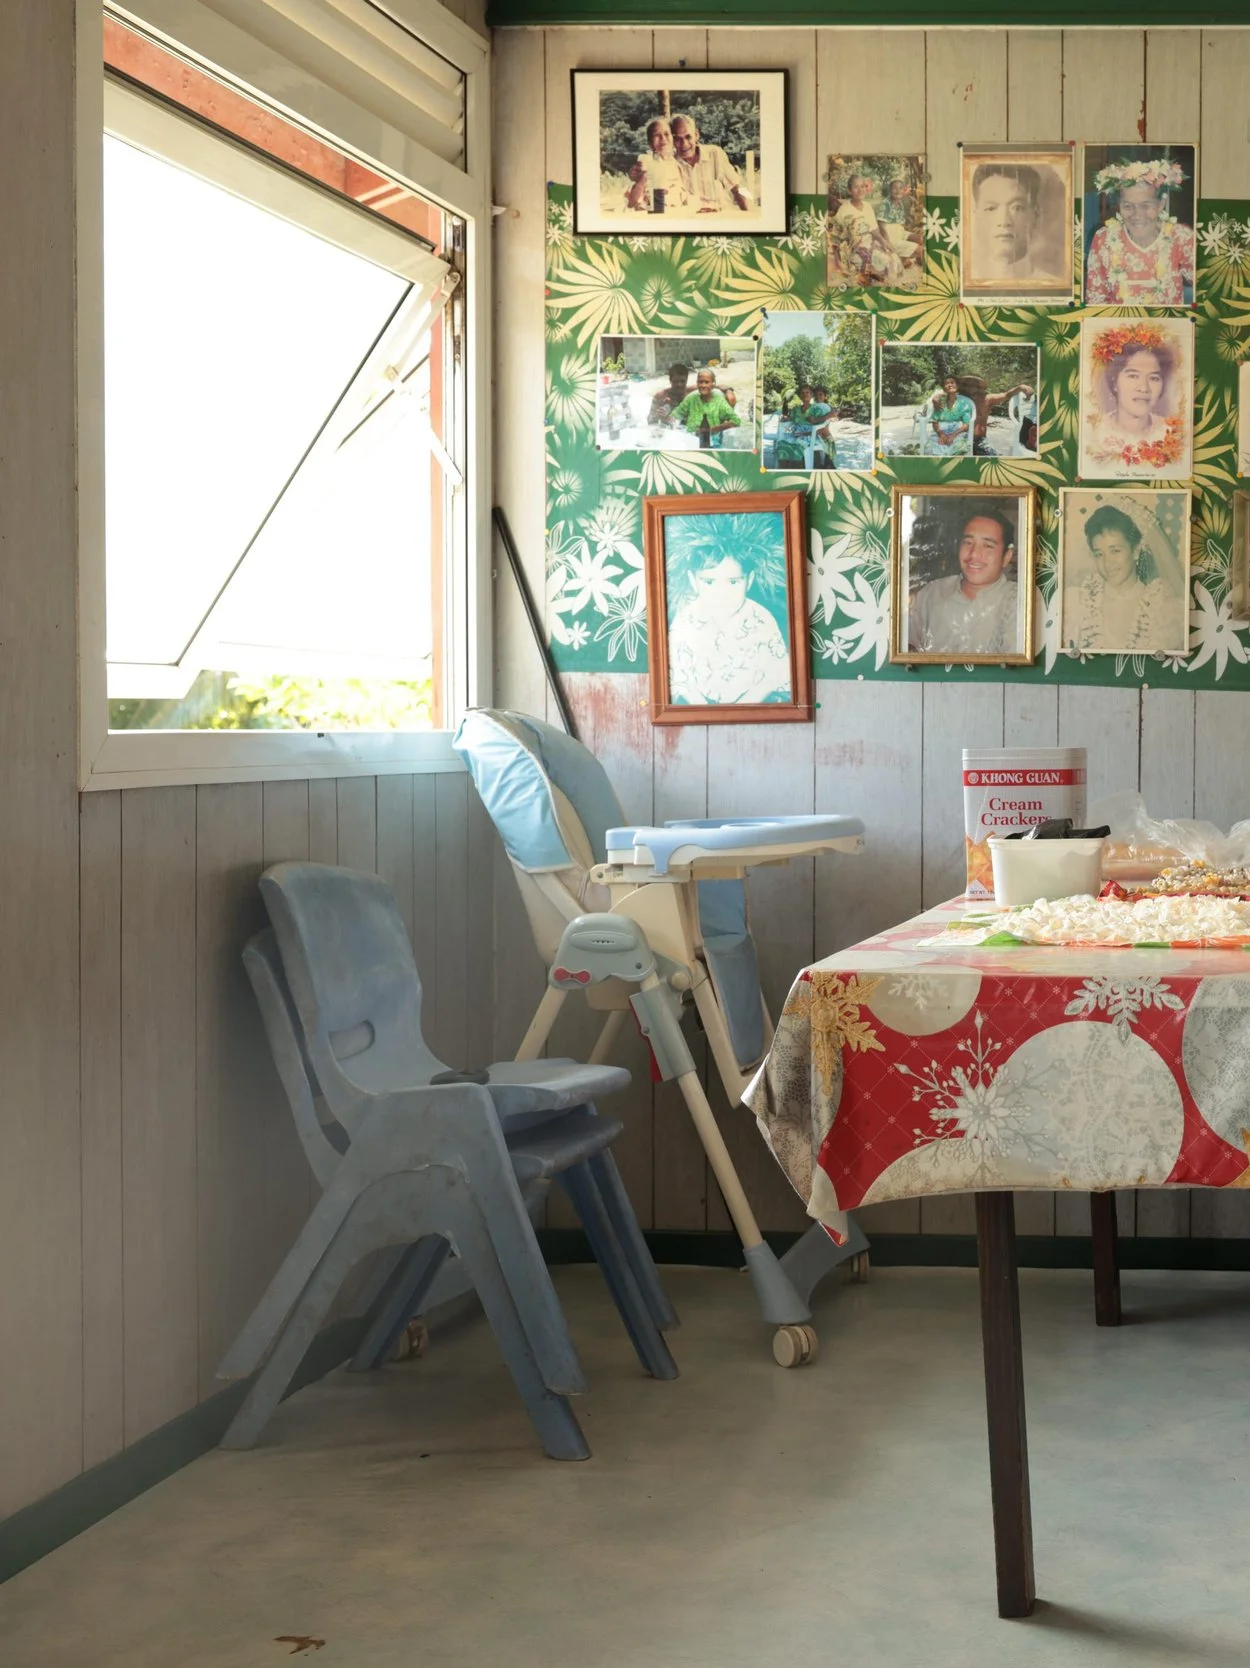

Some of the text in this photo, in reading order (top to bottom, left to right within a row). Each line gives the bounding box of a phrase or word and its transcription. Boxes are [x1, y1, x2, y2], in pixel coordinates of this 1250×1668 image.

[981, 772, 1060, 784] KHONG GUAN
[989, 798, 1043, 811] Cream
